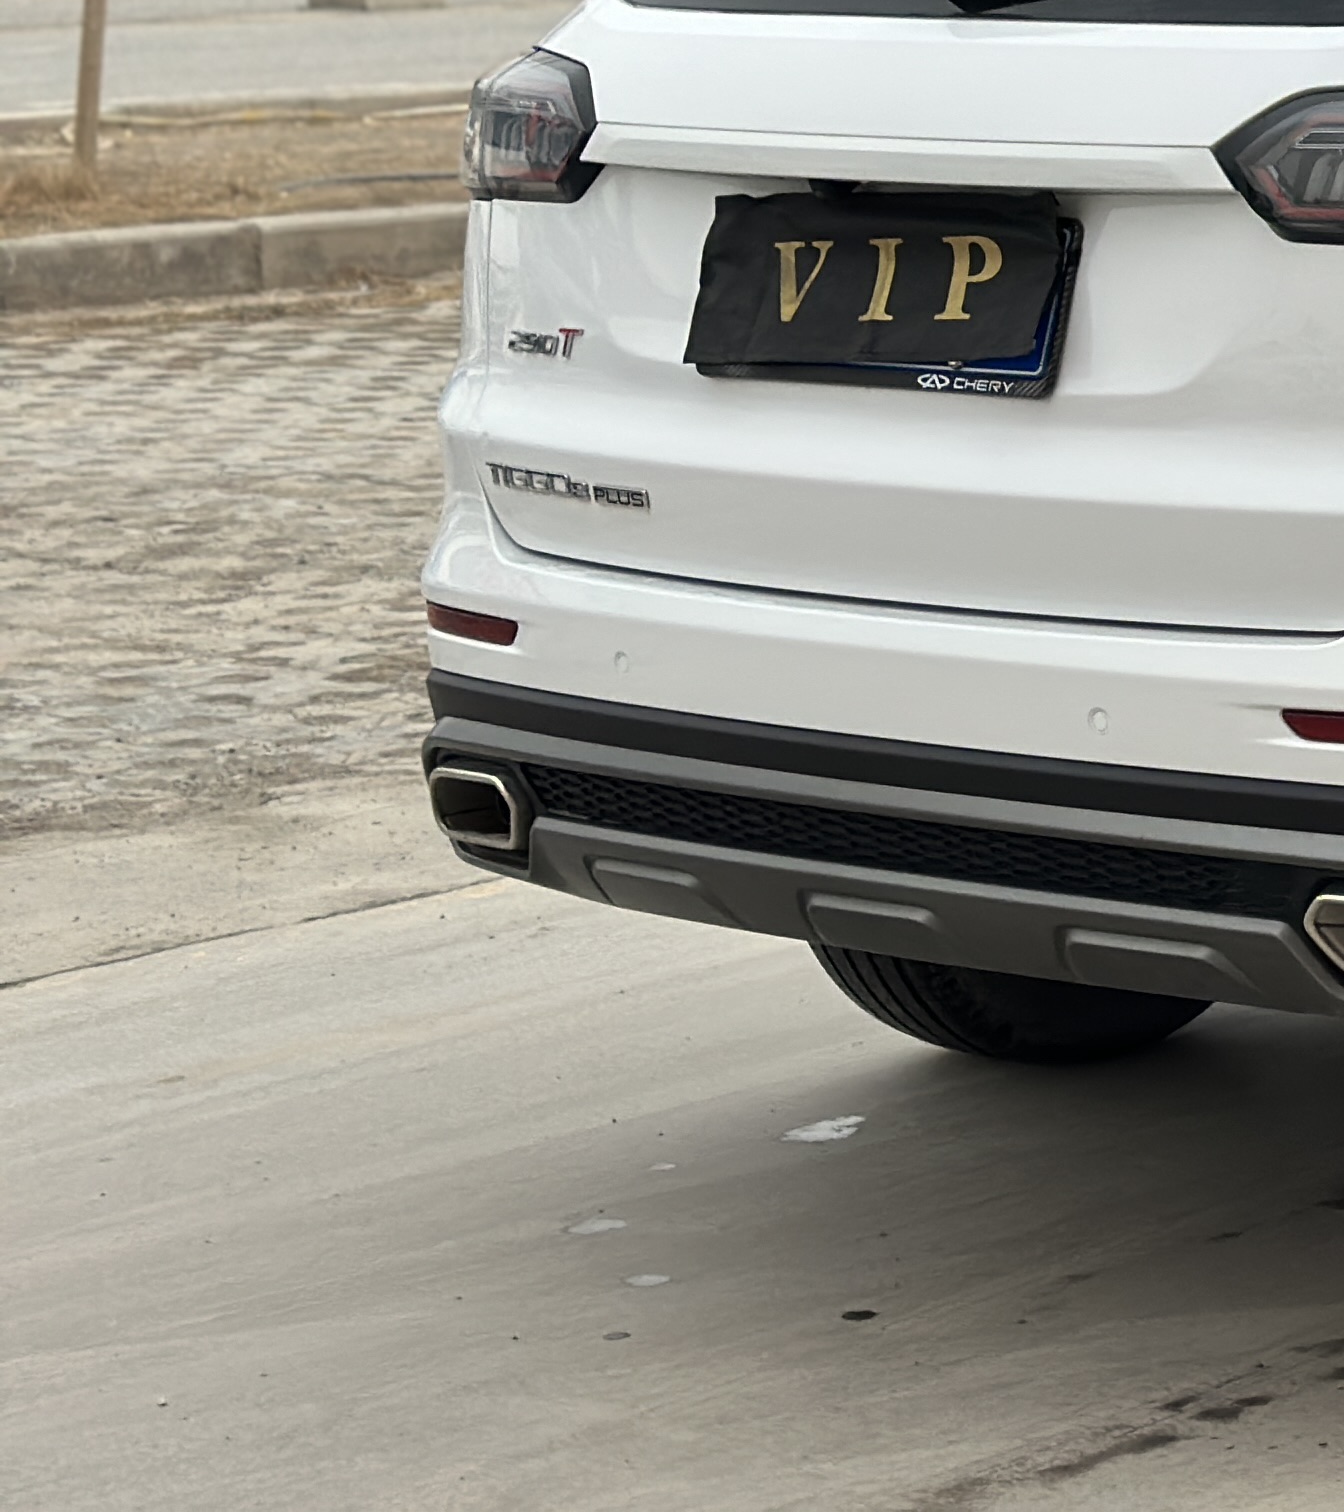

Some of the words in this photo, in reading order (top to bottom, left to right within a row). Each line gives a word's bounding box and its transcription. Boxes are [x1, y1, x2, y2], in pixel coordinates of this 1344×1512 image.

[774, 235, 1003, 322] VIP
[953, 377, 1014, 394] CHERY
[594, 486, 646, 508] PLUS
